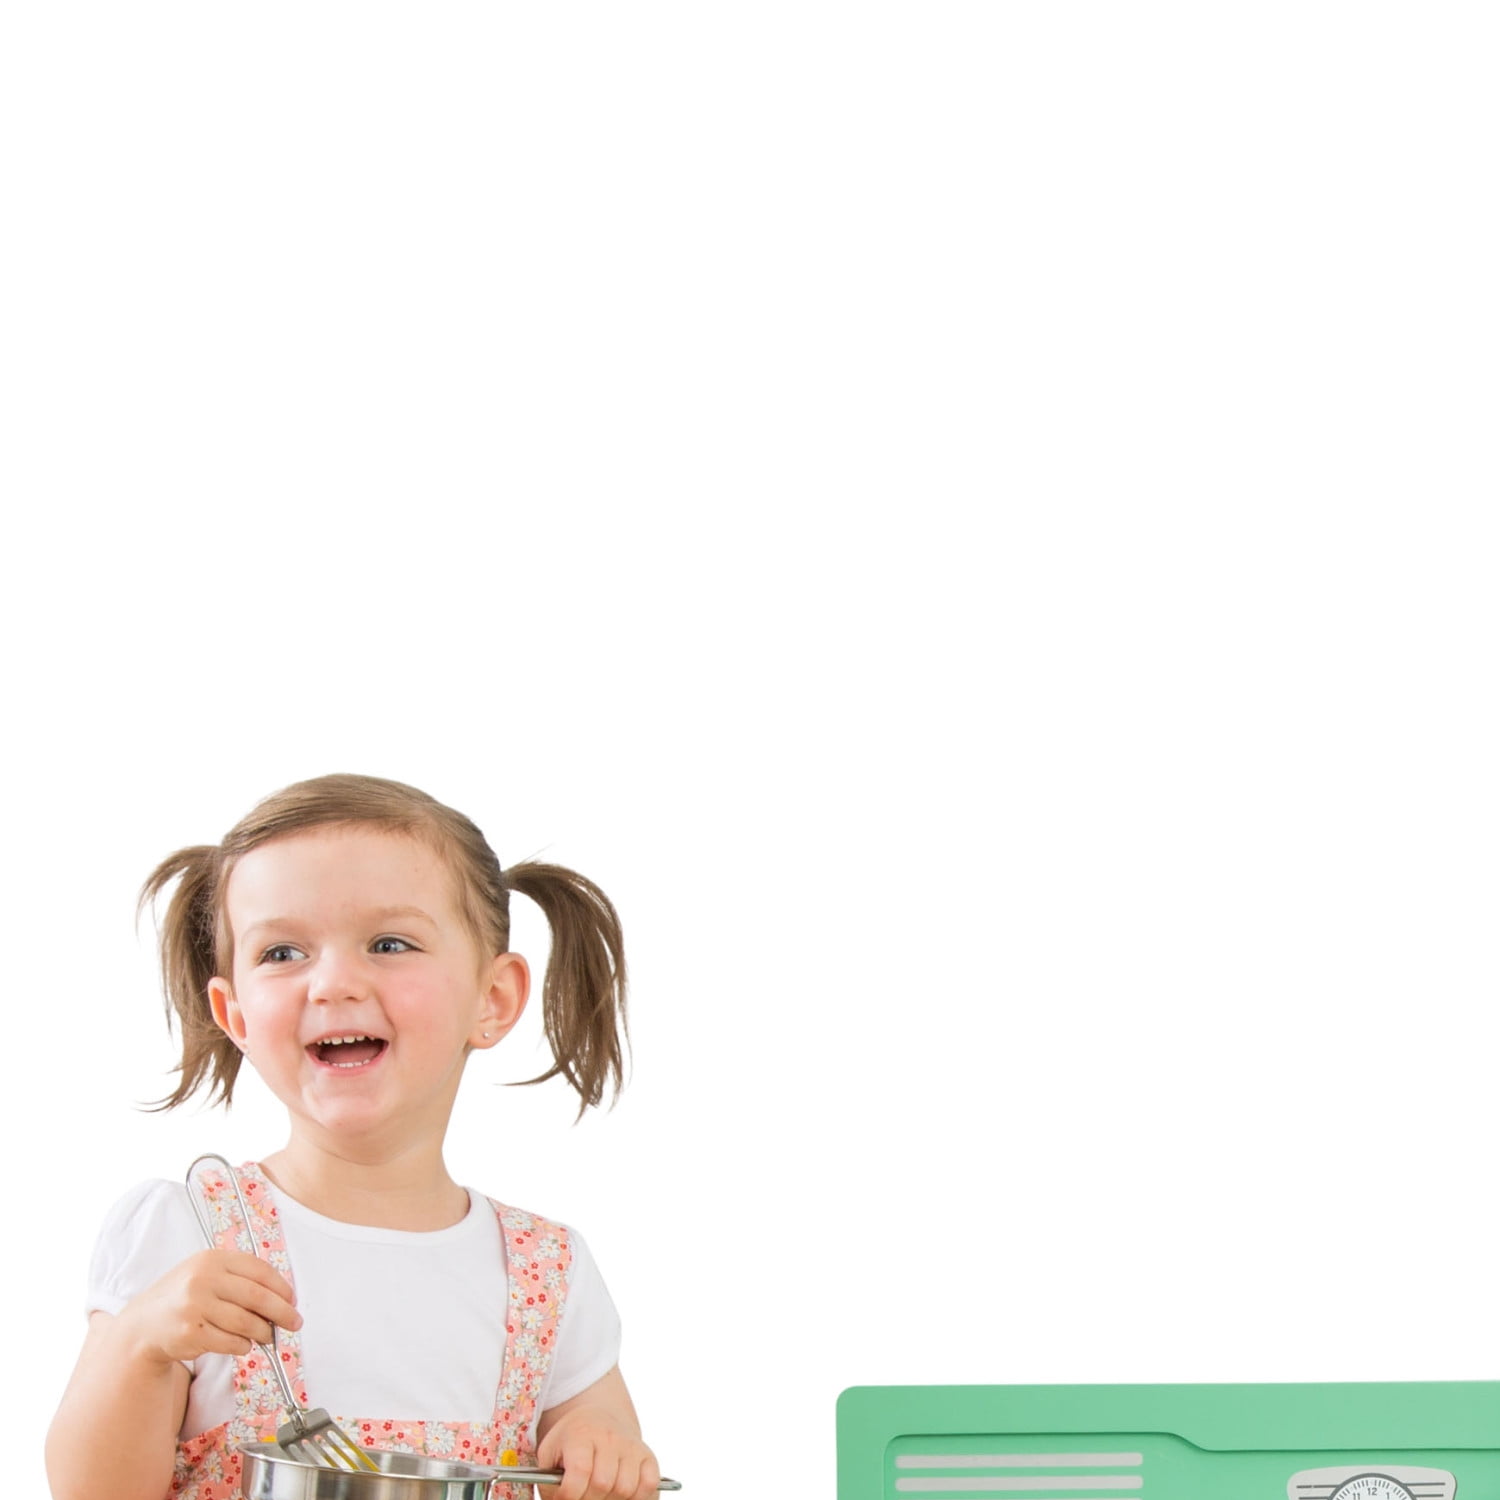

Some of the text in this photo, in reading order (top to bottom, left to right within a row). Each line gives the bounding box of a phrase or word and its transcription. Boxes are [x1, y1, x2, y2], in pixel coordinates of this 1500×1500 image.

[1367, 1487, 1378, 1496] 12
[1352, 1493, 1361, 1500] 11
[1386, 1492, 1390, 1500] 1
